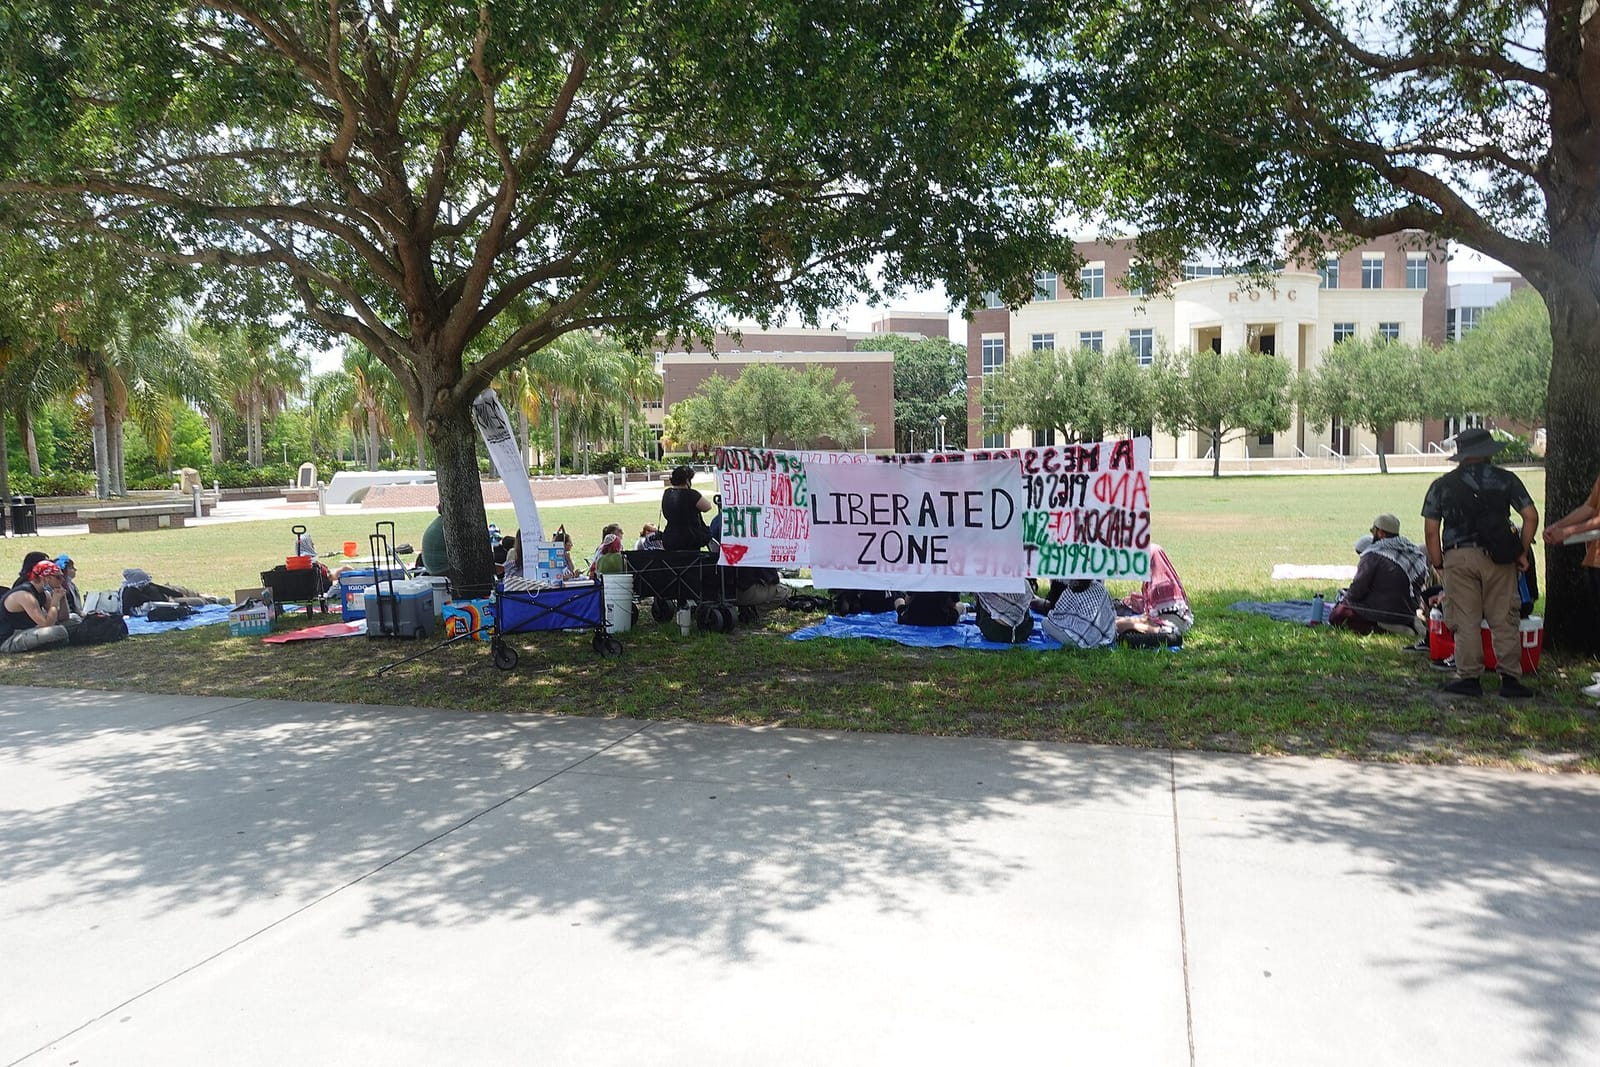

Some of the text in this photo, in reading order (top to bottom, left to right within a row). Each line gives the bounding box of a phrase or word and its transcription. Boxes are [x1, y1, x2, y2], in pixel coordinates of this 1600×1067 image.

[1227, 288, 1297, 303] ROTC
[811, 488, 1014, 530] LIBERATED
[857, 530, 949, 565] ZONE
